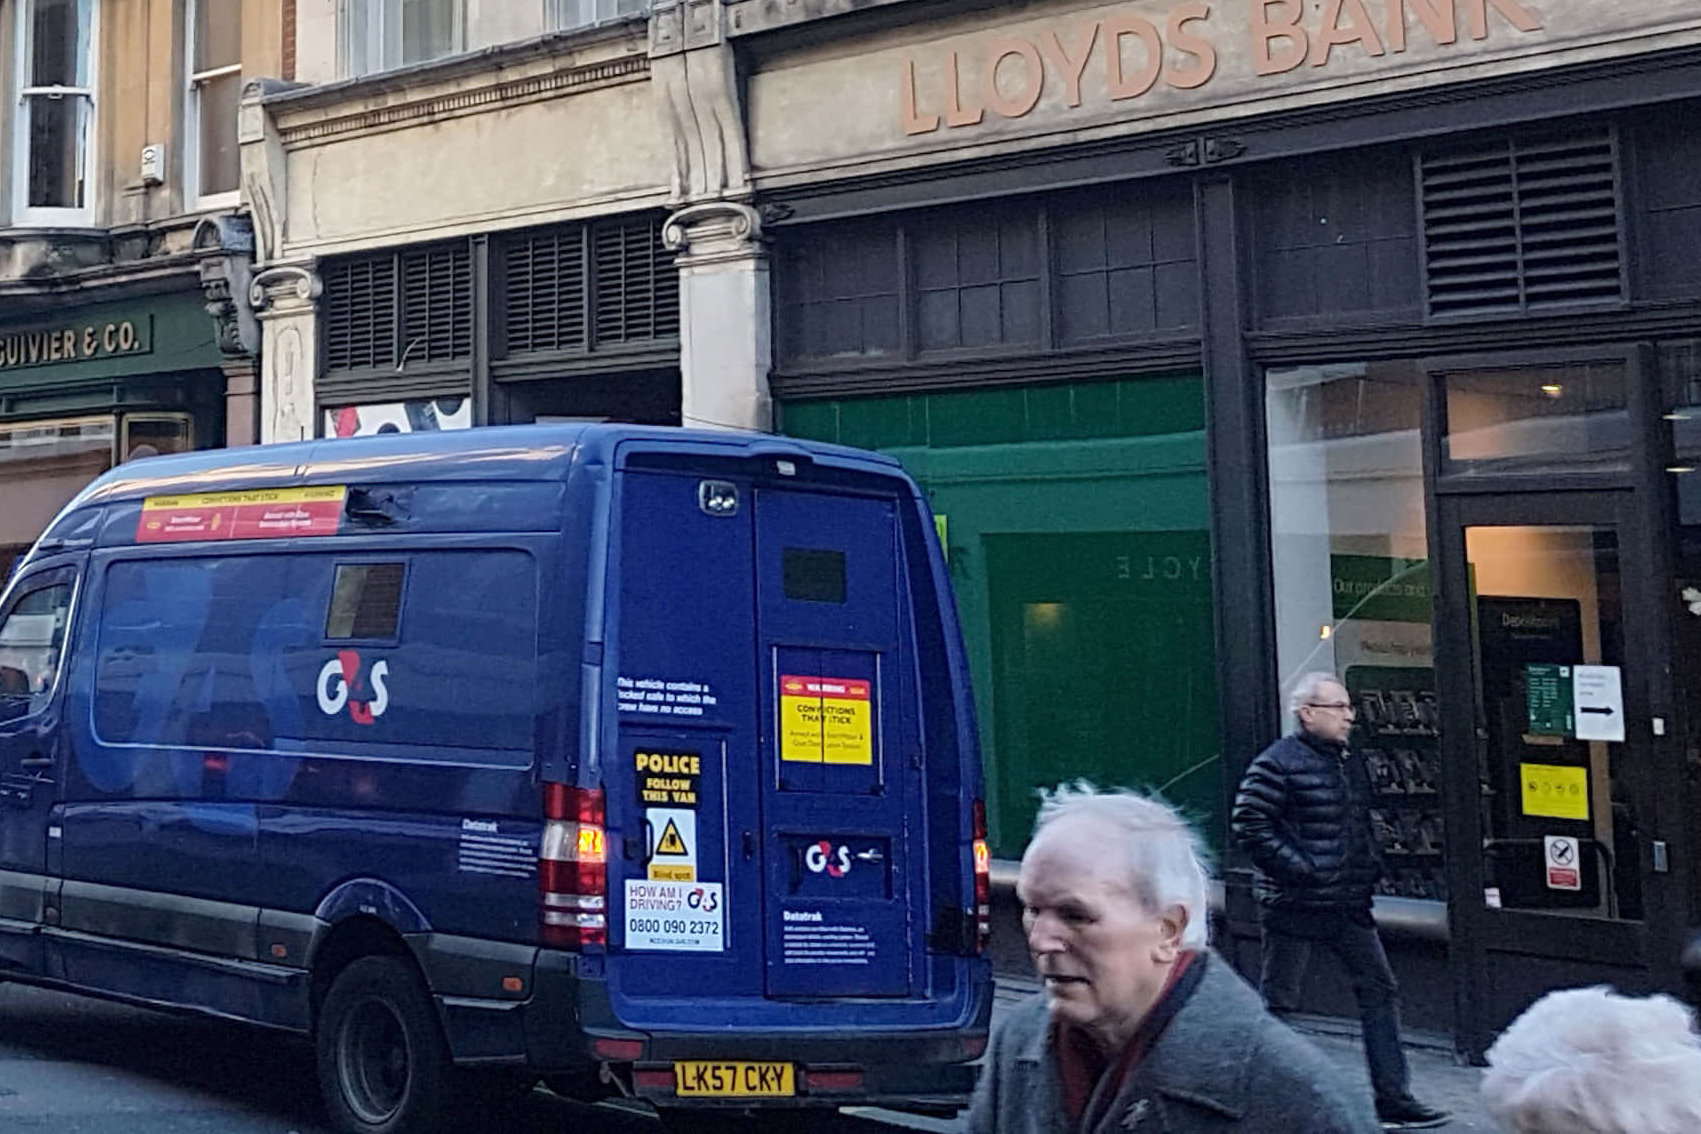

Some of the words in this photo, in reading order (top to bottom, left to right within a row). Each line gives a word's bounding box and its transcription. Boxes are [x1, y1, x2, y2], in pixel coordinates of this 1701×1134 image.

[901, 4, 1217, 136] LLOYDS
[83, 326, 99, 355] &
[104, 321, 140, 352] CO.
[635, 679, 665, 690] vehicle
[666, 682, 701, 692] contains
[676, 693, 701, 703] which
[635, 753, 700, 775] POLICE
[646, 778, 692, 791] FOLLOW
[642, 790, 669, 802] THIS
[672, 791, 697, 803] VAN
[630, 886, 656, 898] HOW
[659, 887, 676, 898] AM
[630, 899, 682, 911] DRIVING?
[783, 910, 823, 922] Datatrak
[630, 919, 660, 933] 0800
[663, 920, 686, 934] 090
[690, 921, 719, 935] 2372
[682, 1065, 738, 1091] LK57
[744, 1065, 785, 1092] CKY
